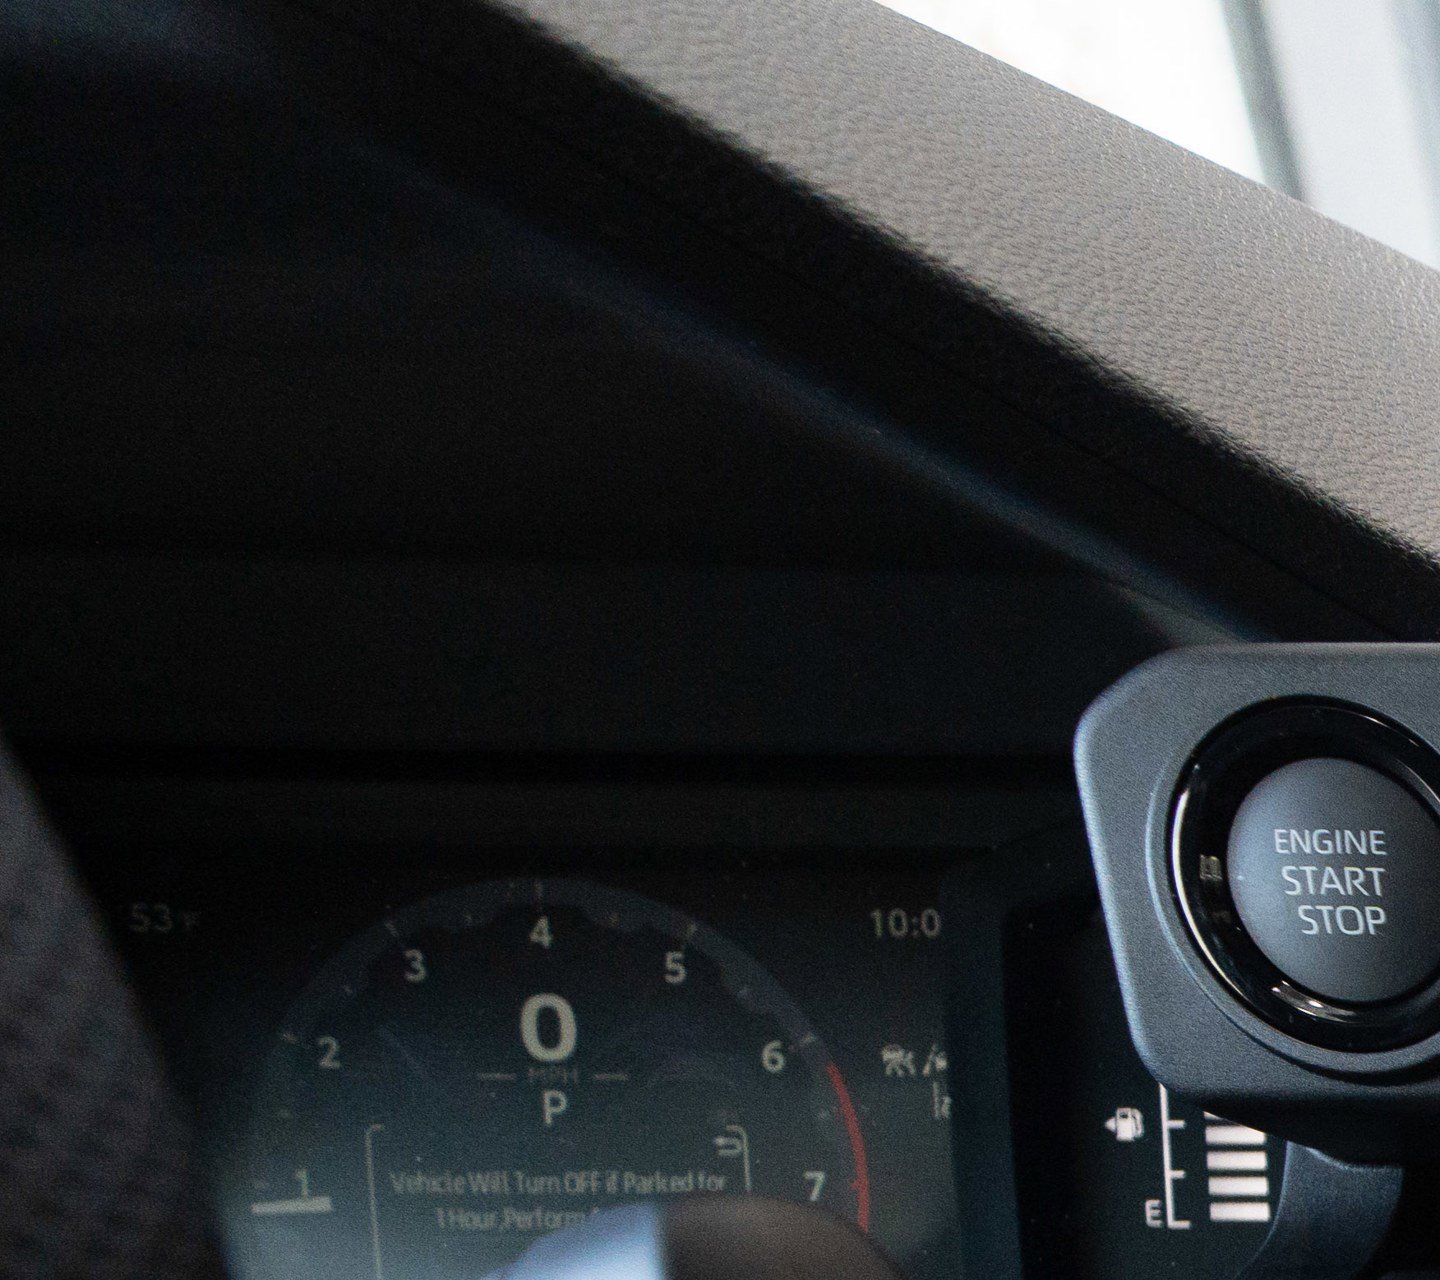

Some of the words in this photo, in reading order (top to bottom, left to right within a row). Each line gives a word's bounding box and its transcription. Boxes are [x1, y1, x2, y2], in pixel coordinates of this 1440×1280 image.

[1274, 828, 1387, 856] ENGINE
[1281, 866, 1386, 898] START
[529, 917, 552, 948] 4
[1300, 906, 1387, 935] STOP
[404, 950, 428, 982] 3
[664, 950, 688, 983] 5
[520, 993, 577, 1061] 0
[317, 1038, 341, 1070] 2
[761, 1040, 785, 1073] 6
[543, 1090, 567, 1124] P
[293, 1170, 311, 1198] 1
[564, 1170, 599, 1194] OFF
[805, 1172, 827, 1201] 7
[1145, 1199, 1162, 1227] E
